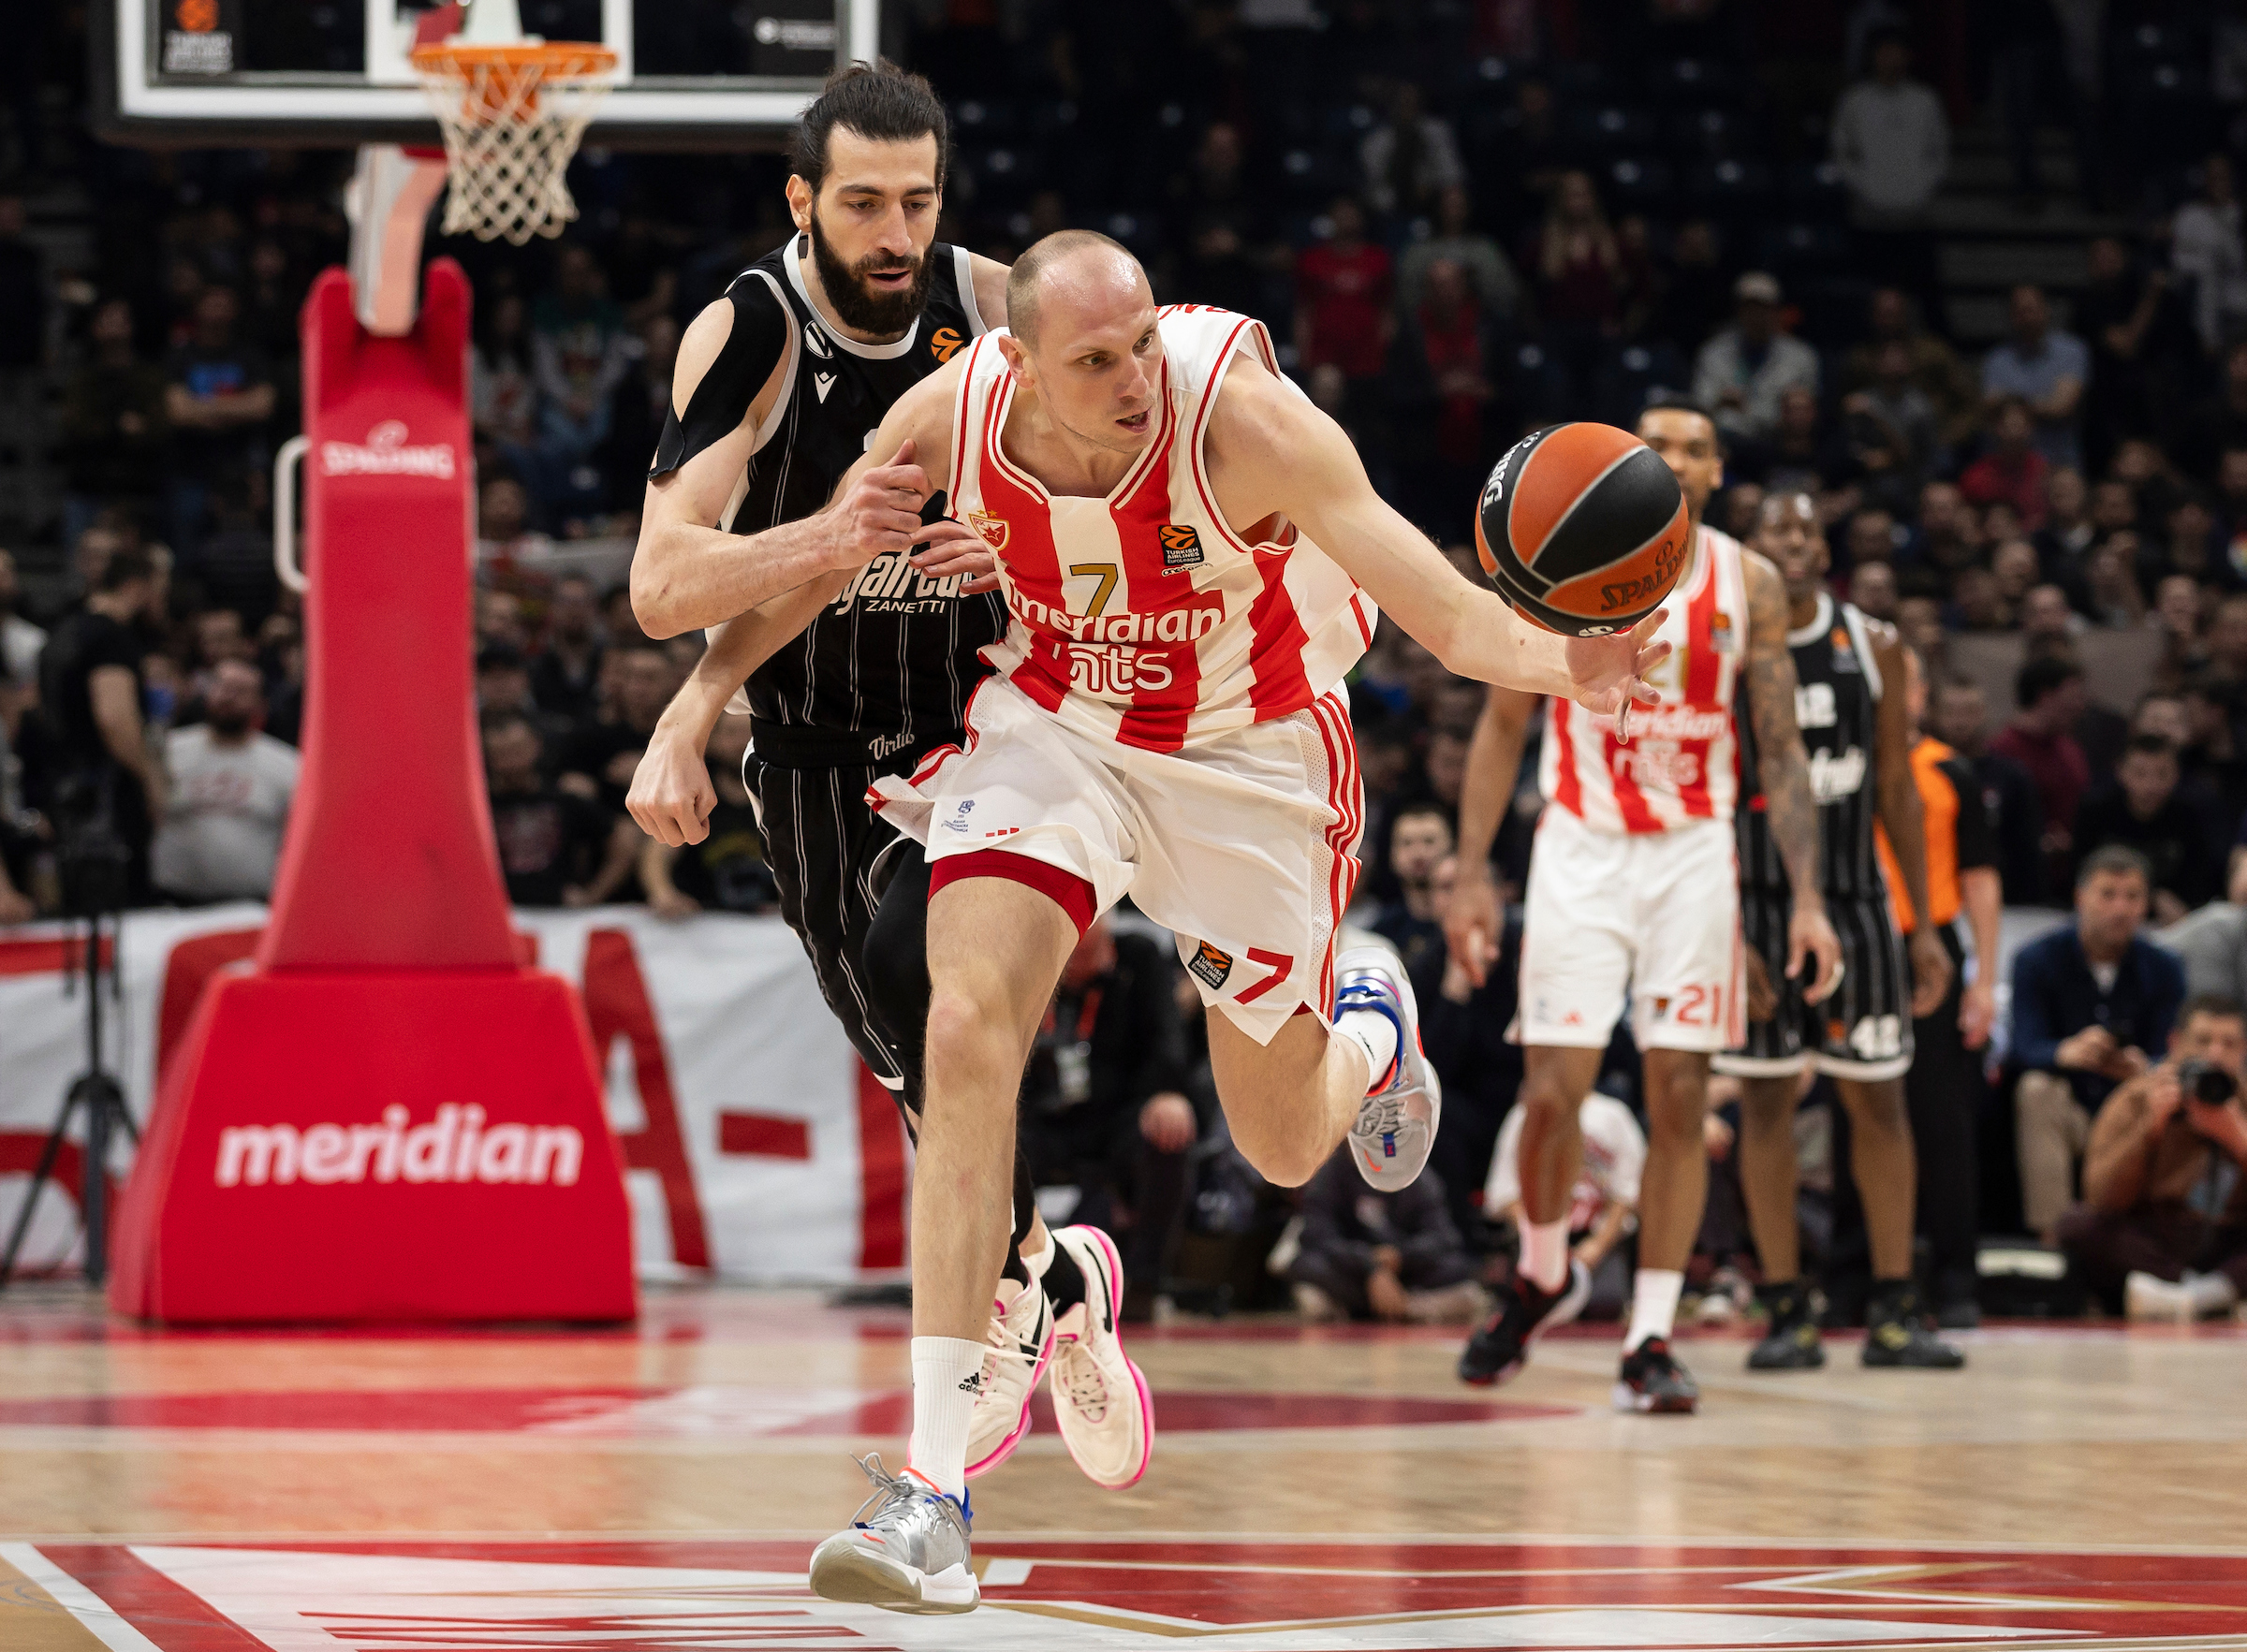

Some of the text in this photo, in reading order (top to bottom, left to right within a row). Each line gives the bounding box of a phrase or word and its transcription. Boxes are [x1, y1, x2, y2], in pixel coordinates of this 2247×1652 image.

[865, 600, 946, 613] ZANETTI
[1069, 563, 1119, 617] 7
[1010, 581, 1222, 643] meridian
[869, 734, 915, 760] Virtus
[1194, 959, 1222, 983] AIRLINES
[1198, 955, 1226, 979] TURKISH
[1232, 946, 1294, 1005] 7
[1676, 985, 1721, 1026] 21
[215, 1103, 584, 1187] meridian
